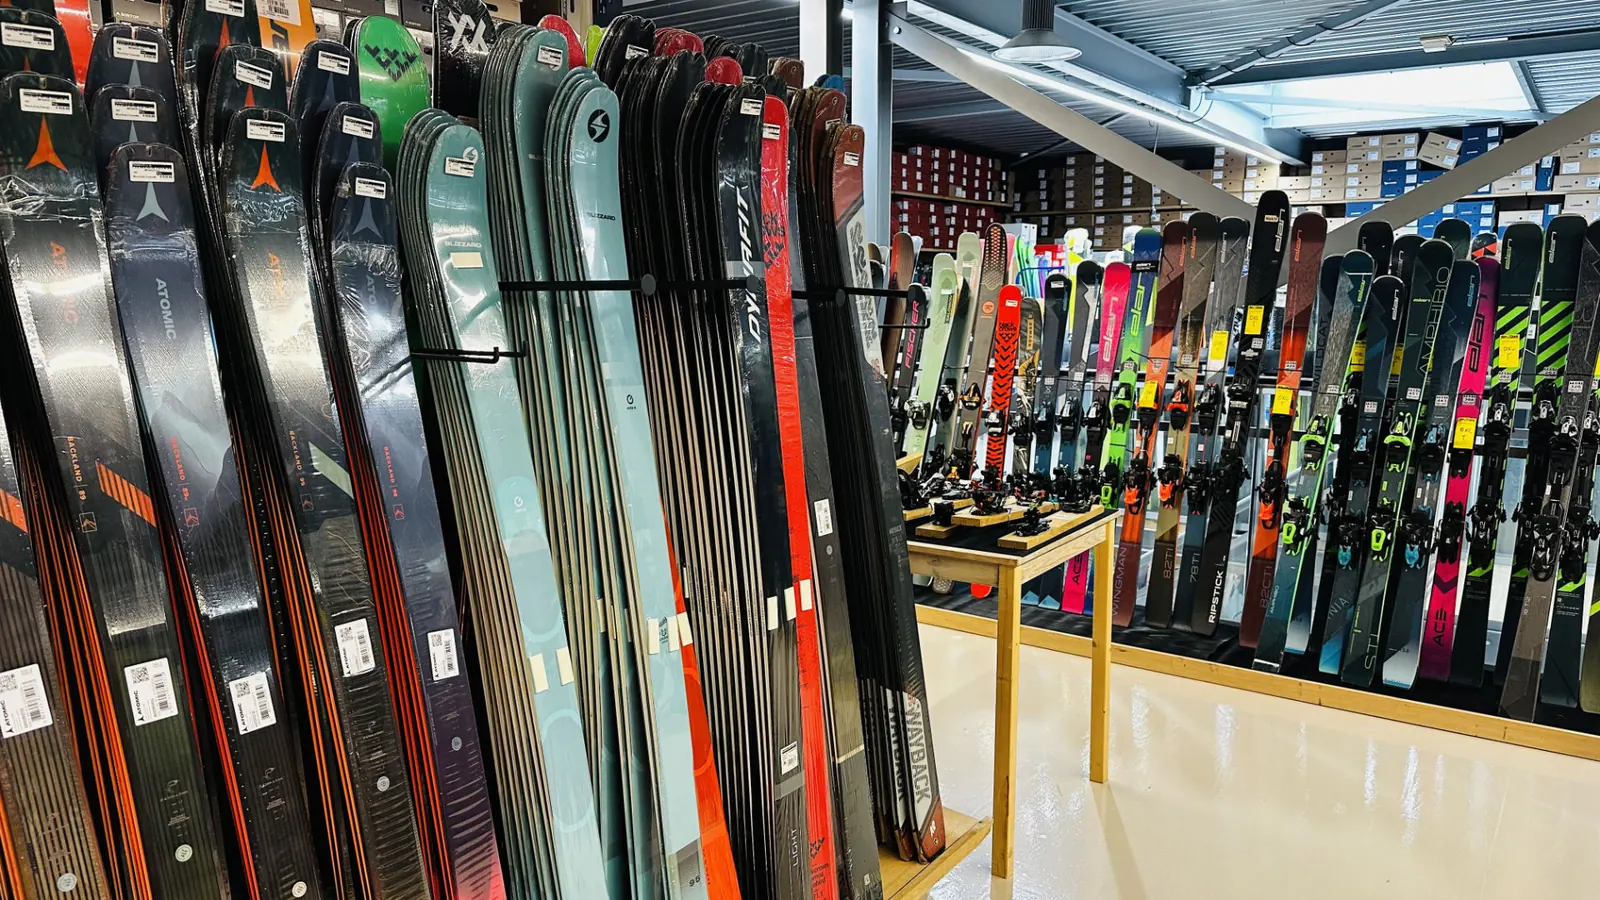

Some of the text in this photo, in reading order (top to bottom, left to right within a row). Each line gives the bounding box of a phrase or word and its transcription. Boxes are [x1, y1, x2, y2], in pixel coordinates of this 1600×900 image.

[445, 240, 482, 249] BLIZZARD
[155, 277, 177, 340] ATOMIC
[66, 436, 83, 483] BACKLAND
[170, 437, 186, 482] BACKLAND
[1112, 546, 1128, 617] WINGMAN
[1189, 552, 1200, 584] 78TI
[1208, 570, 1224, 624] RIPSTICK
[1433, 607, 1447, 647] ACE
[133, 690, 143, 715] ATOMIC
[237, 703, 247, 727] ATOMIC
[905, 709, 931, 804] WAYBACK
